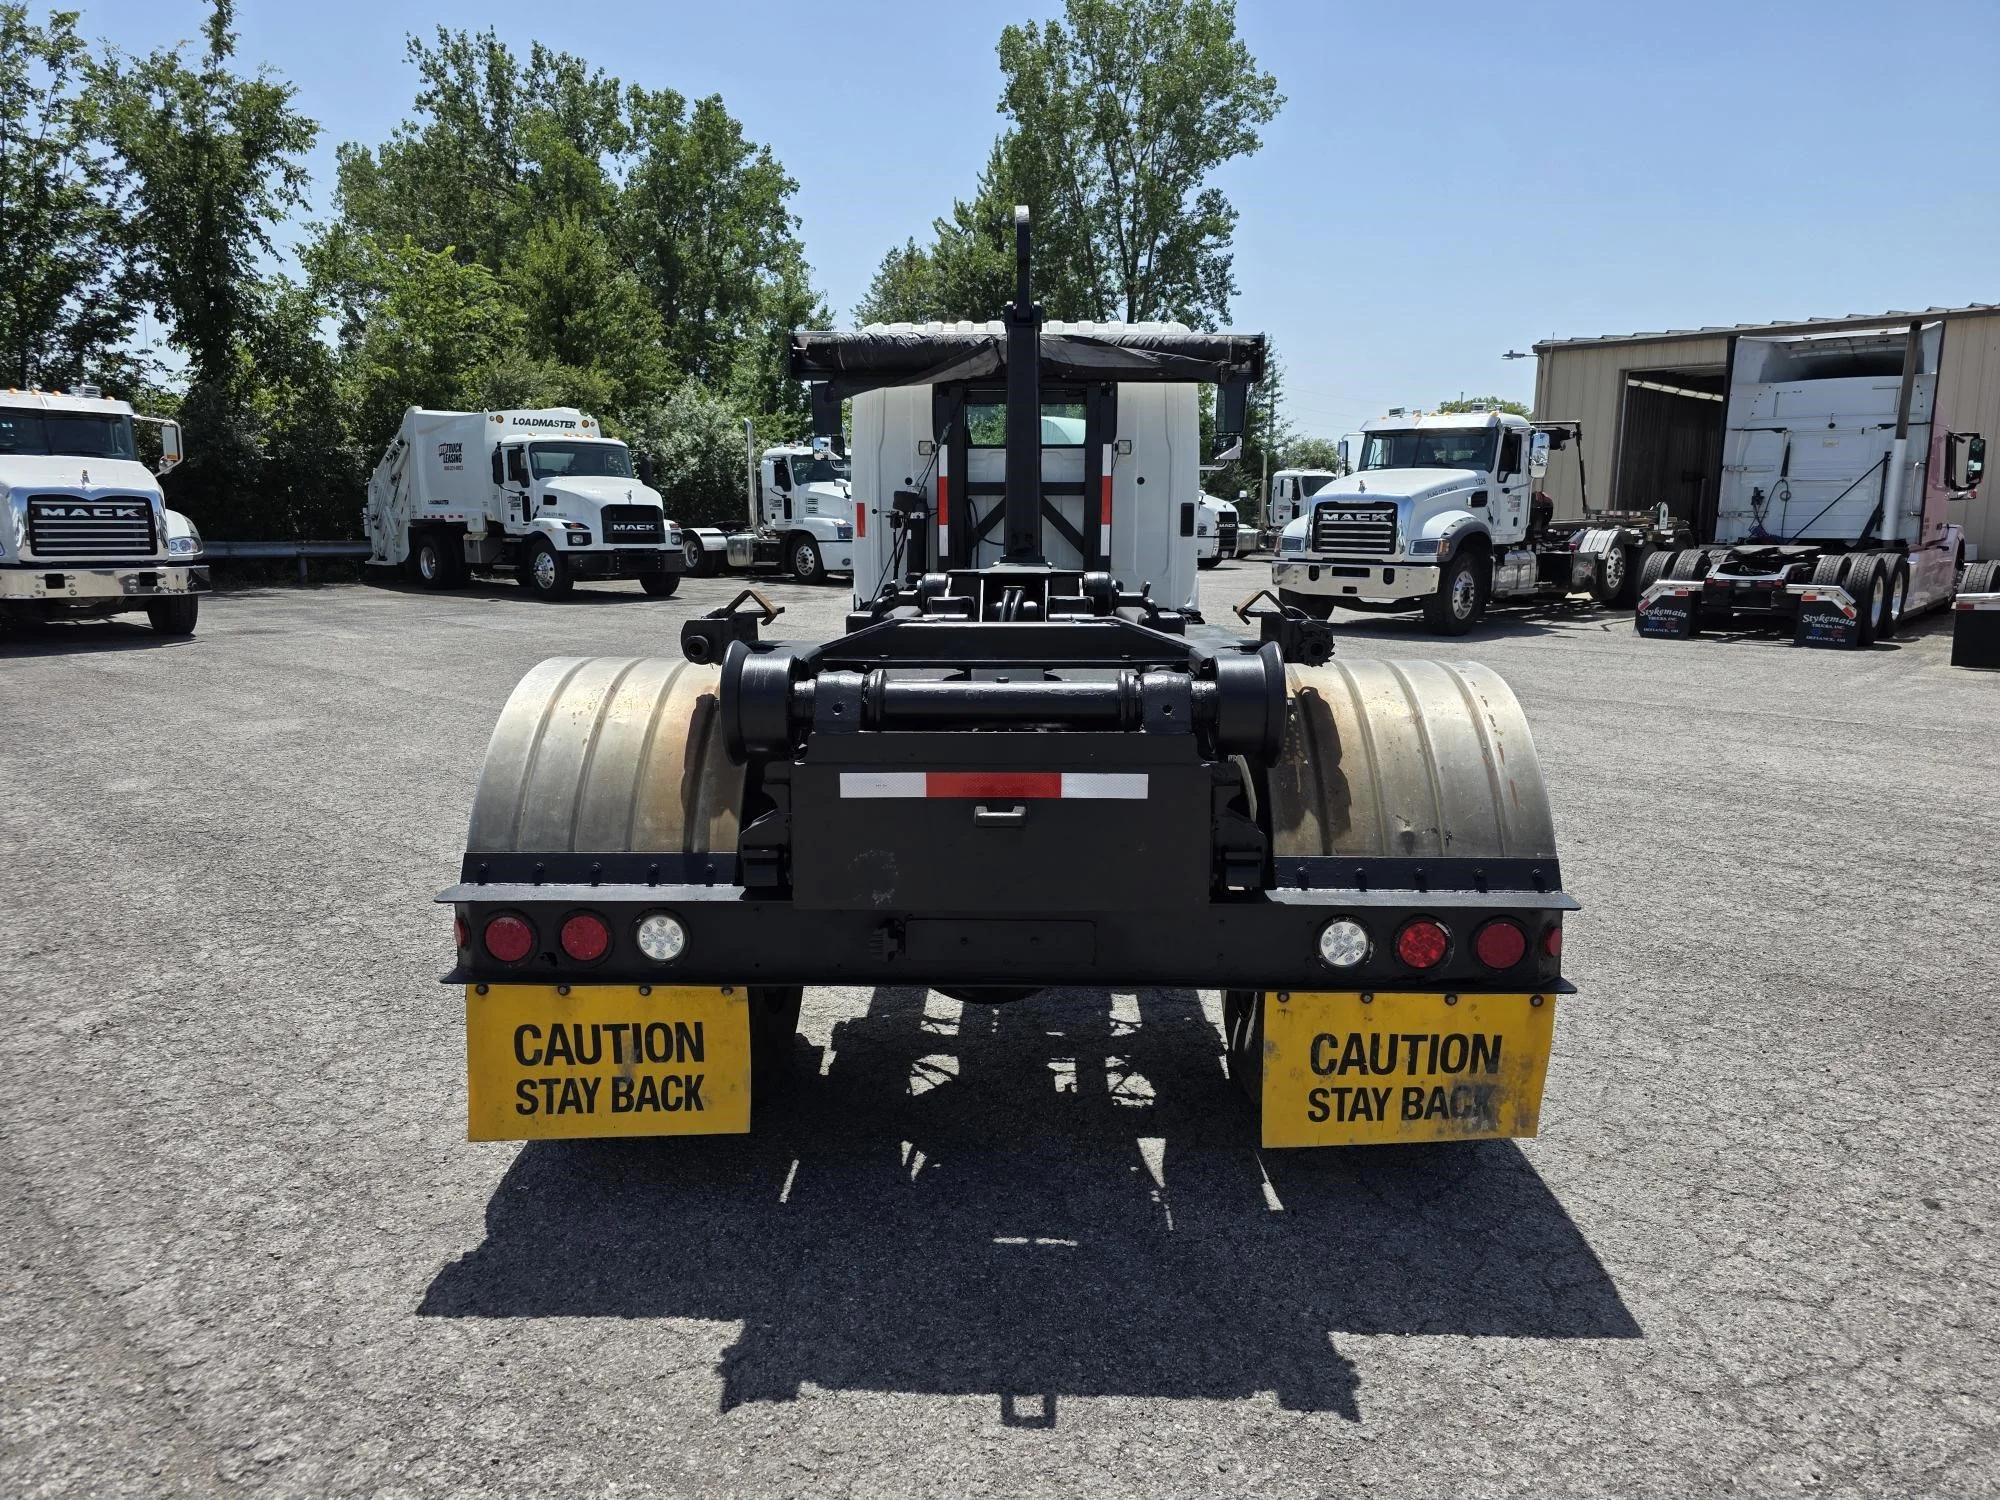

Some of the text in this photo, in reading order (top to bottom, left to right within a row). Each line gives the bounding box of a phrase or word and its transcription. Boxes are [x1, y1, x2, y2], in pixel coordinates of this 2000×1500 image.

[513, 417, 576, 429] LOADMASTER
[446, 443, 462, 453] TRUCK
[443, 453, 462, 463] LEASING
[40, 508, 140, 517] MACK
[1322, 513, 1388, 521] MACK
[1640, 607, 1687, 618] Stykemain
[1802, 613, 1856, 626] Stykemain
[514, 1022, 704, 1066] CAUTION
[1310, 1033, 1502, 1075] CAUTION
[515, 1074, 704, 1115] STAY BACK
[1307, 1084, 1497, 1122] STAY BACK
